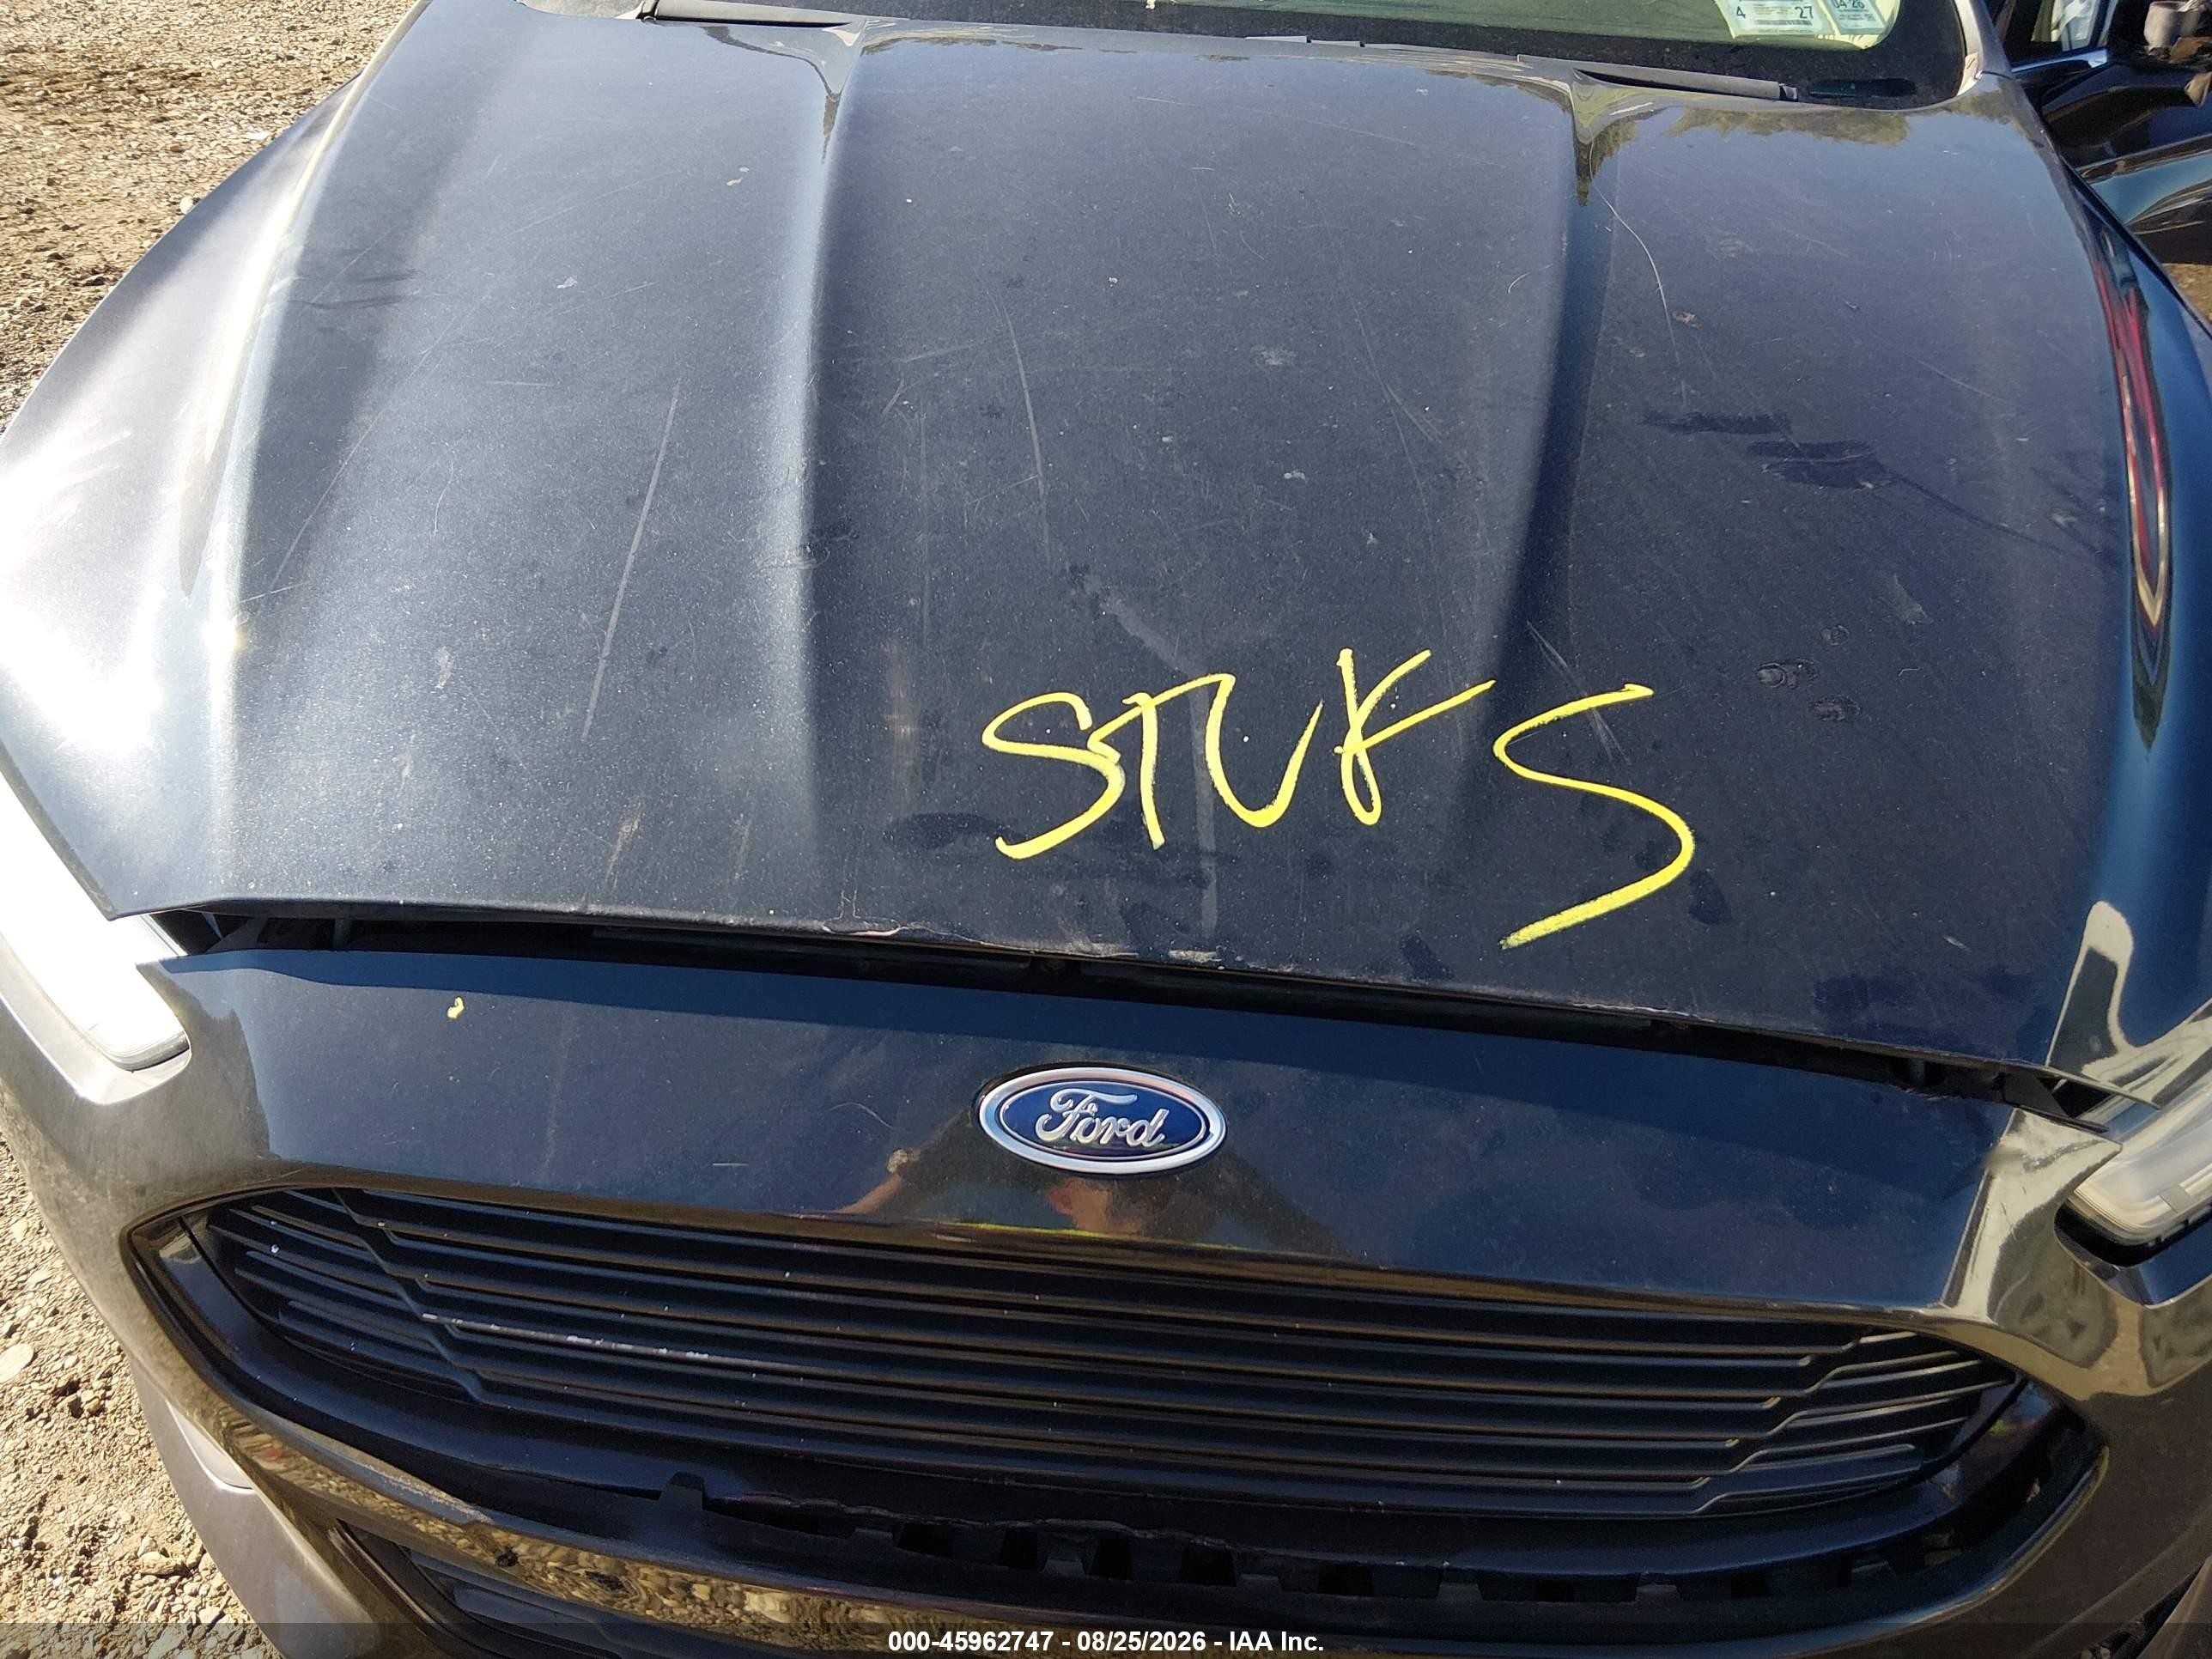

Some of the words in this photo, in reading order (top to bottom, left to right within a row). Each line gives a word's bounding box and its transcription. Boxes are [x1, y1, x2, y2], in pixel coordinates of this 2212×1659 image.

[1736, 6, 1746, 18] 4
[1795, 6, 1814, 19] 27
[1036, 1088, 1170, 1147] Ford
